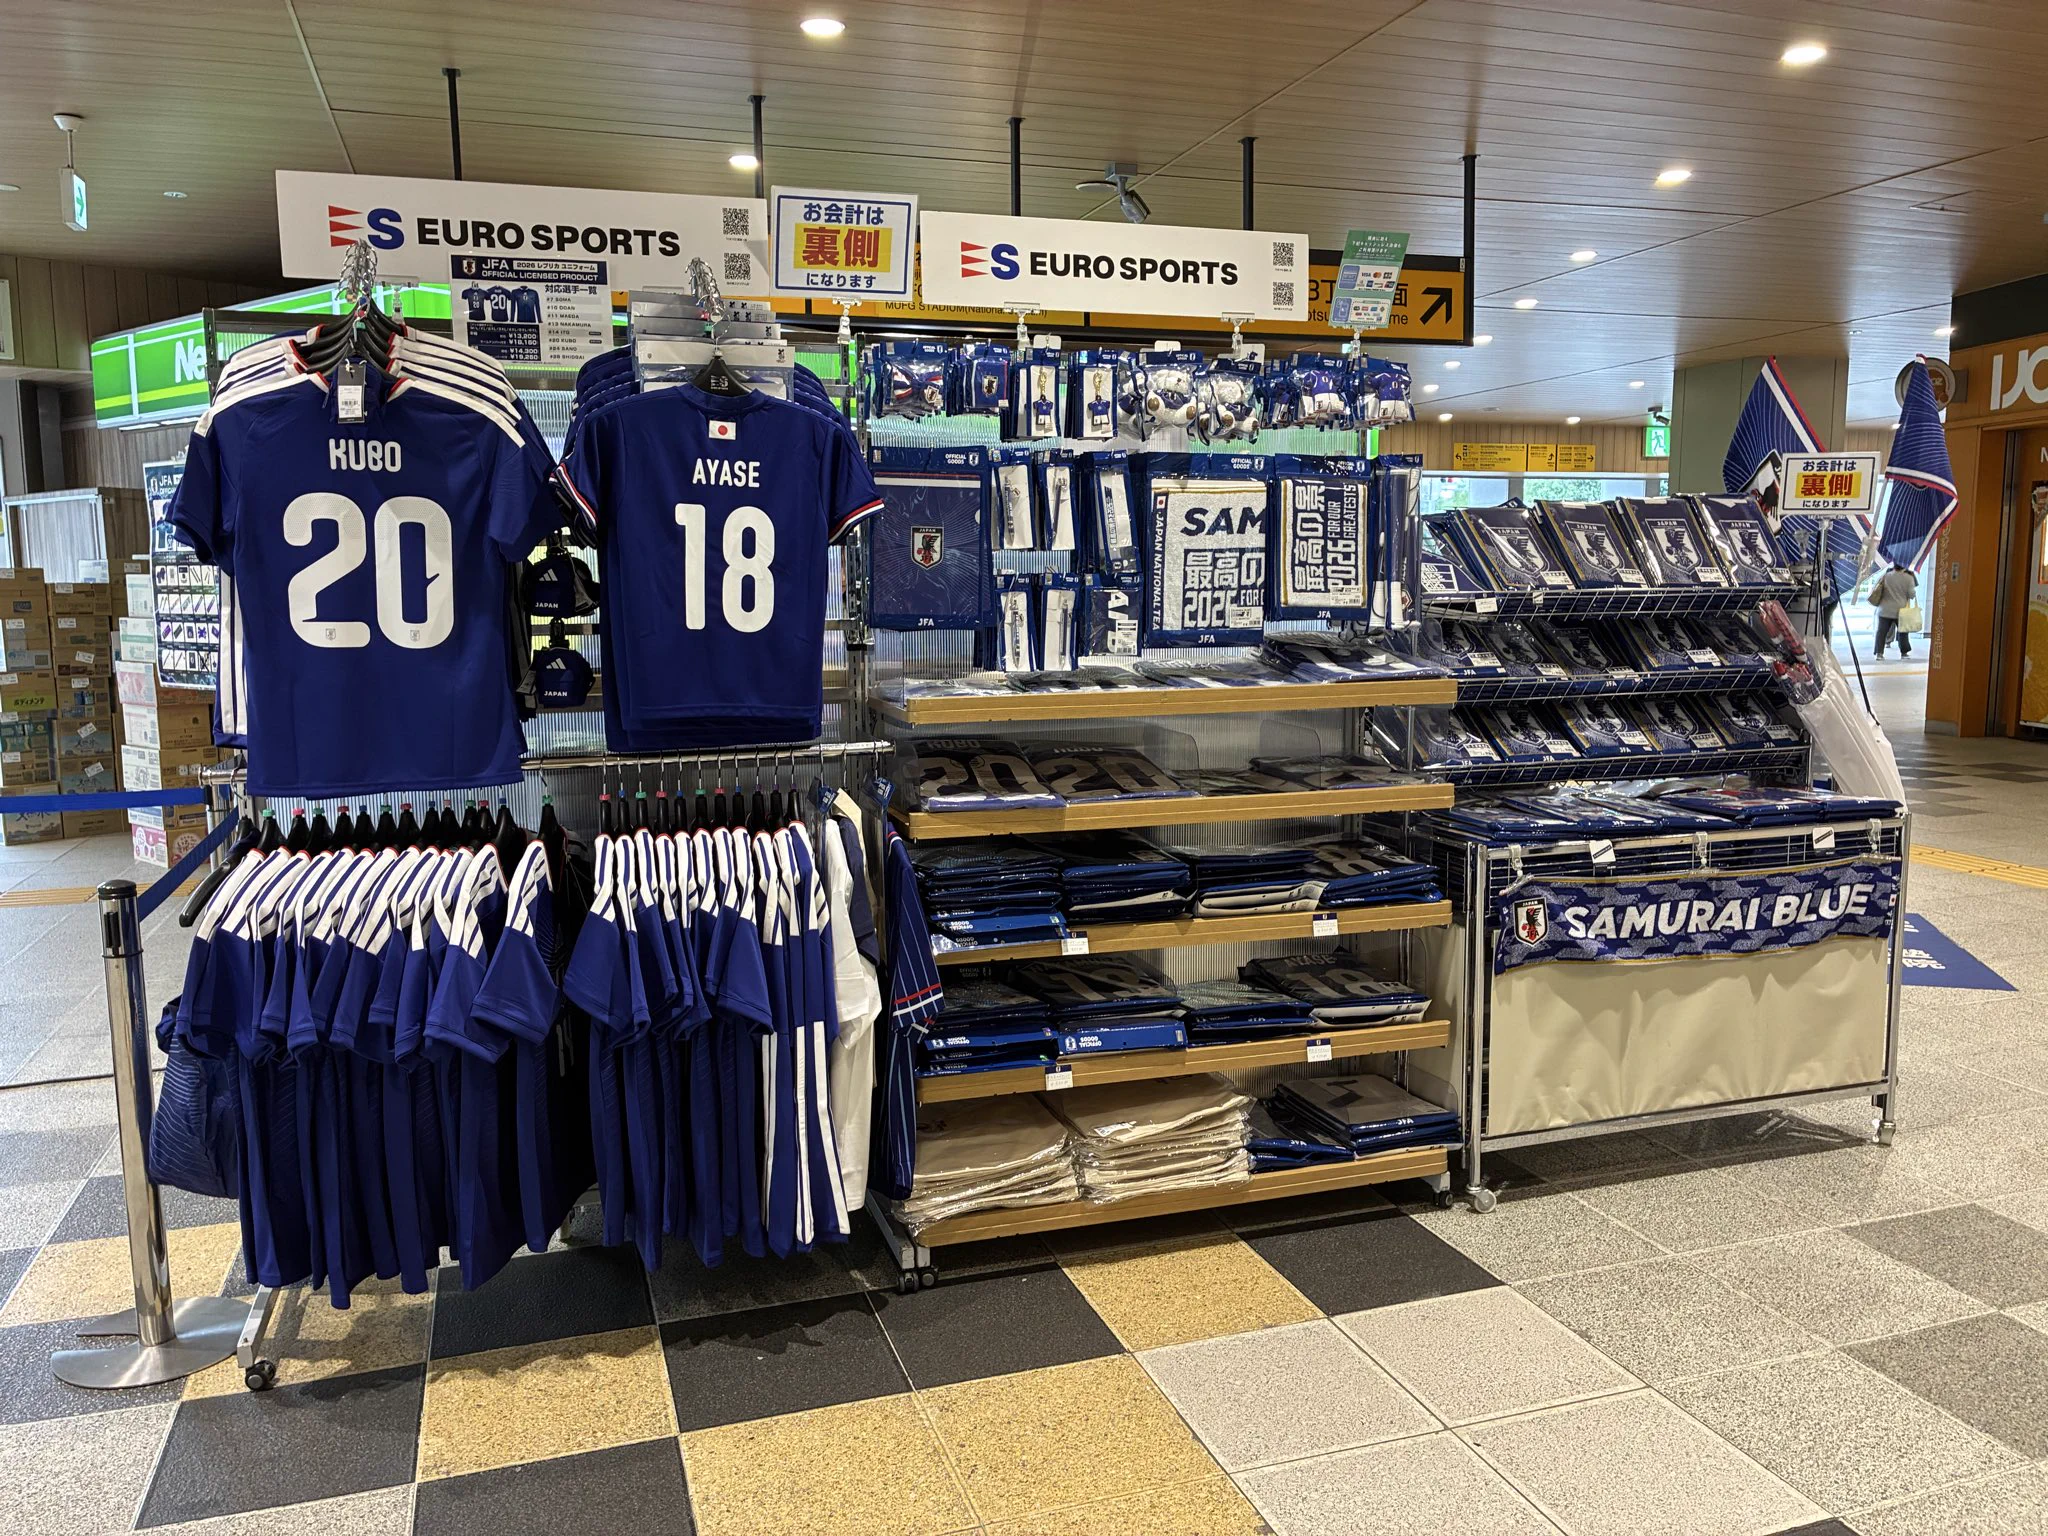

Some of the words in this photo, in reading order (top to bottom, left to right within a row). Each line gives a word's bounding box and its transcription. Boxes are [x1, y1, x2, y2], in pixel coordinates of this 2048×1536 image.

[803, 203, 884, 225] お会計は
[417, 217, 525, 250] EURO
[531, 226, 681, 257] SPORTS
[802, 227, 880, 267] 裏側
[482, 259, 509, 270] JFA
[1030, 251, 1115, 280] EURO
[1119, 258, 1239, 286] SPORTS
[519, 272, 559, 280] LICENSED
[560, 273, 599, 281] PRODUCT
[806, 273, 877, 288] になります
[509, 332, 537, 340] ¥13,200
[329, 438, 402, 473] KUBO
[1231, 457, 1252, 465] OFFICIAL
[1802, 460, 1857, 472] お会計は
[159, 474, 173, 487] JFA
[692, 458, 761, 488] AYASE
[1801, 473, 1854, 497] 裏側
[1802, 499, 1851, 508] になります
[1154, 511, 1165, 551] JAPAN
[283, 491, 455, 649] 20
[674, 502, 776, 633] 18
[1152, 552, 1163, 606] NATIONAL
[1184, 551, 1266, 590] 最高の
[917, 618, 935, 627] JFA
[1317, 610, 1332, 619] JFA
[1198, 634, 1216, 644] JFA
[919, 754, 1050, 799] 20
[1038, 755, 1180, 798] 20
[1564, 897, 1761, 939] SAMURAI
[1772, 883, 1876, 928] BLUE
[1525, 928, 1540, 939] JFA
[1284, 954, 1337, 968] AYASE
[1285, 968, 1383, 999] 18
[1079, 1040, 1102, 1048] OFFICIAL
